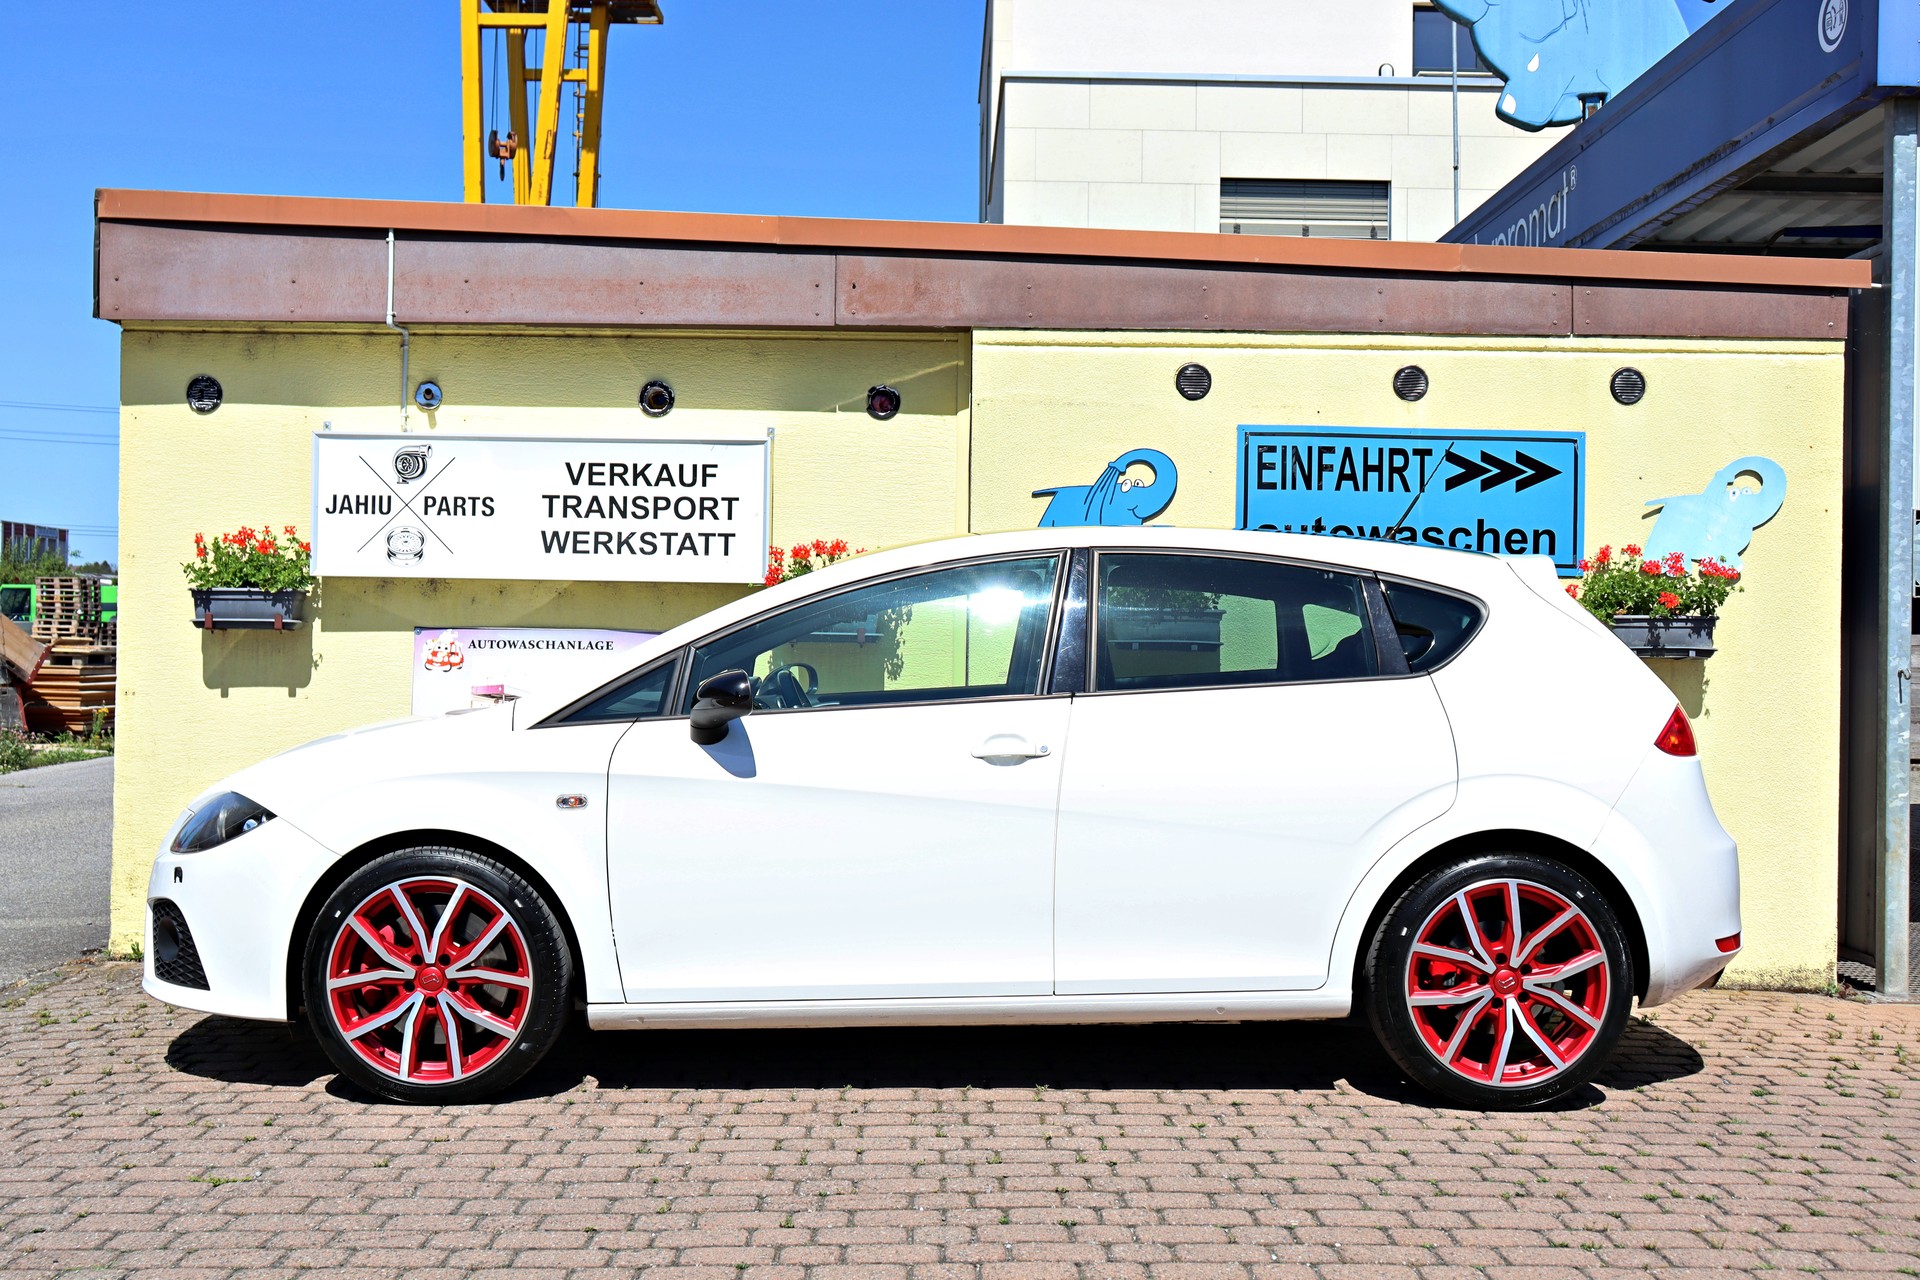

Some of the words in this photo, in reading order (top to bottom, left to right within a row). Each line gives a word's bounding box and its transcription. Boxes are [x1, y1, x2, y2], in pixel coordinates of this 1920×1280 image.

[564, 462, 719, 488] VERKAUF
[1257, 444, 1434, 493] EINFAHRT
[325, 494, 392, 516] JAHIU
[423, 496, 495, 517] PARTS
[541, 494, 740, 521] TRANSPORT
[540, 530, 736, 557] WERKSTATT
[468, 639, 614, 651] AUTOWASCHANLAGE
